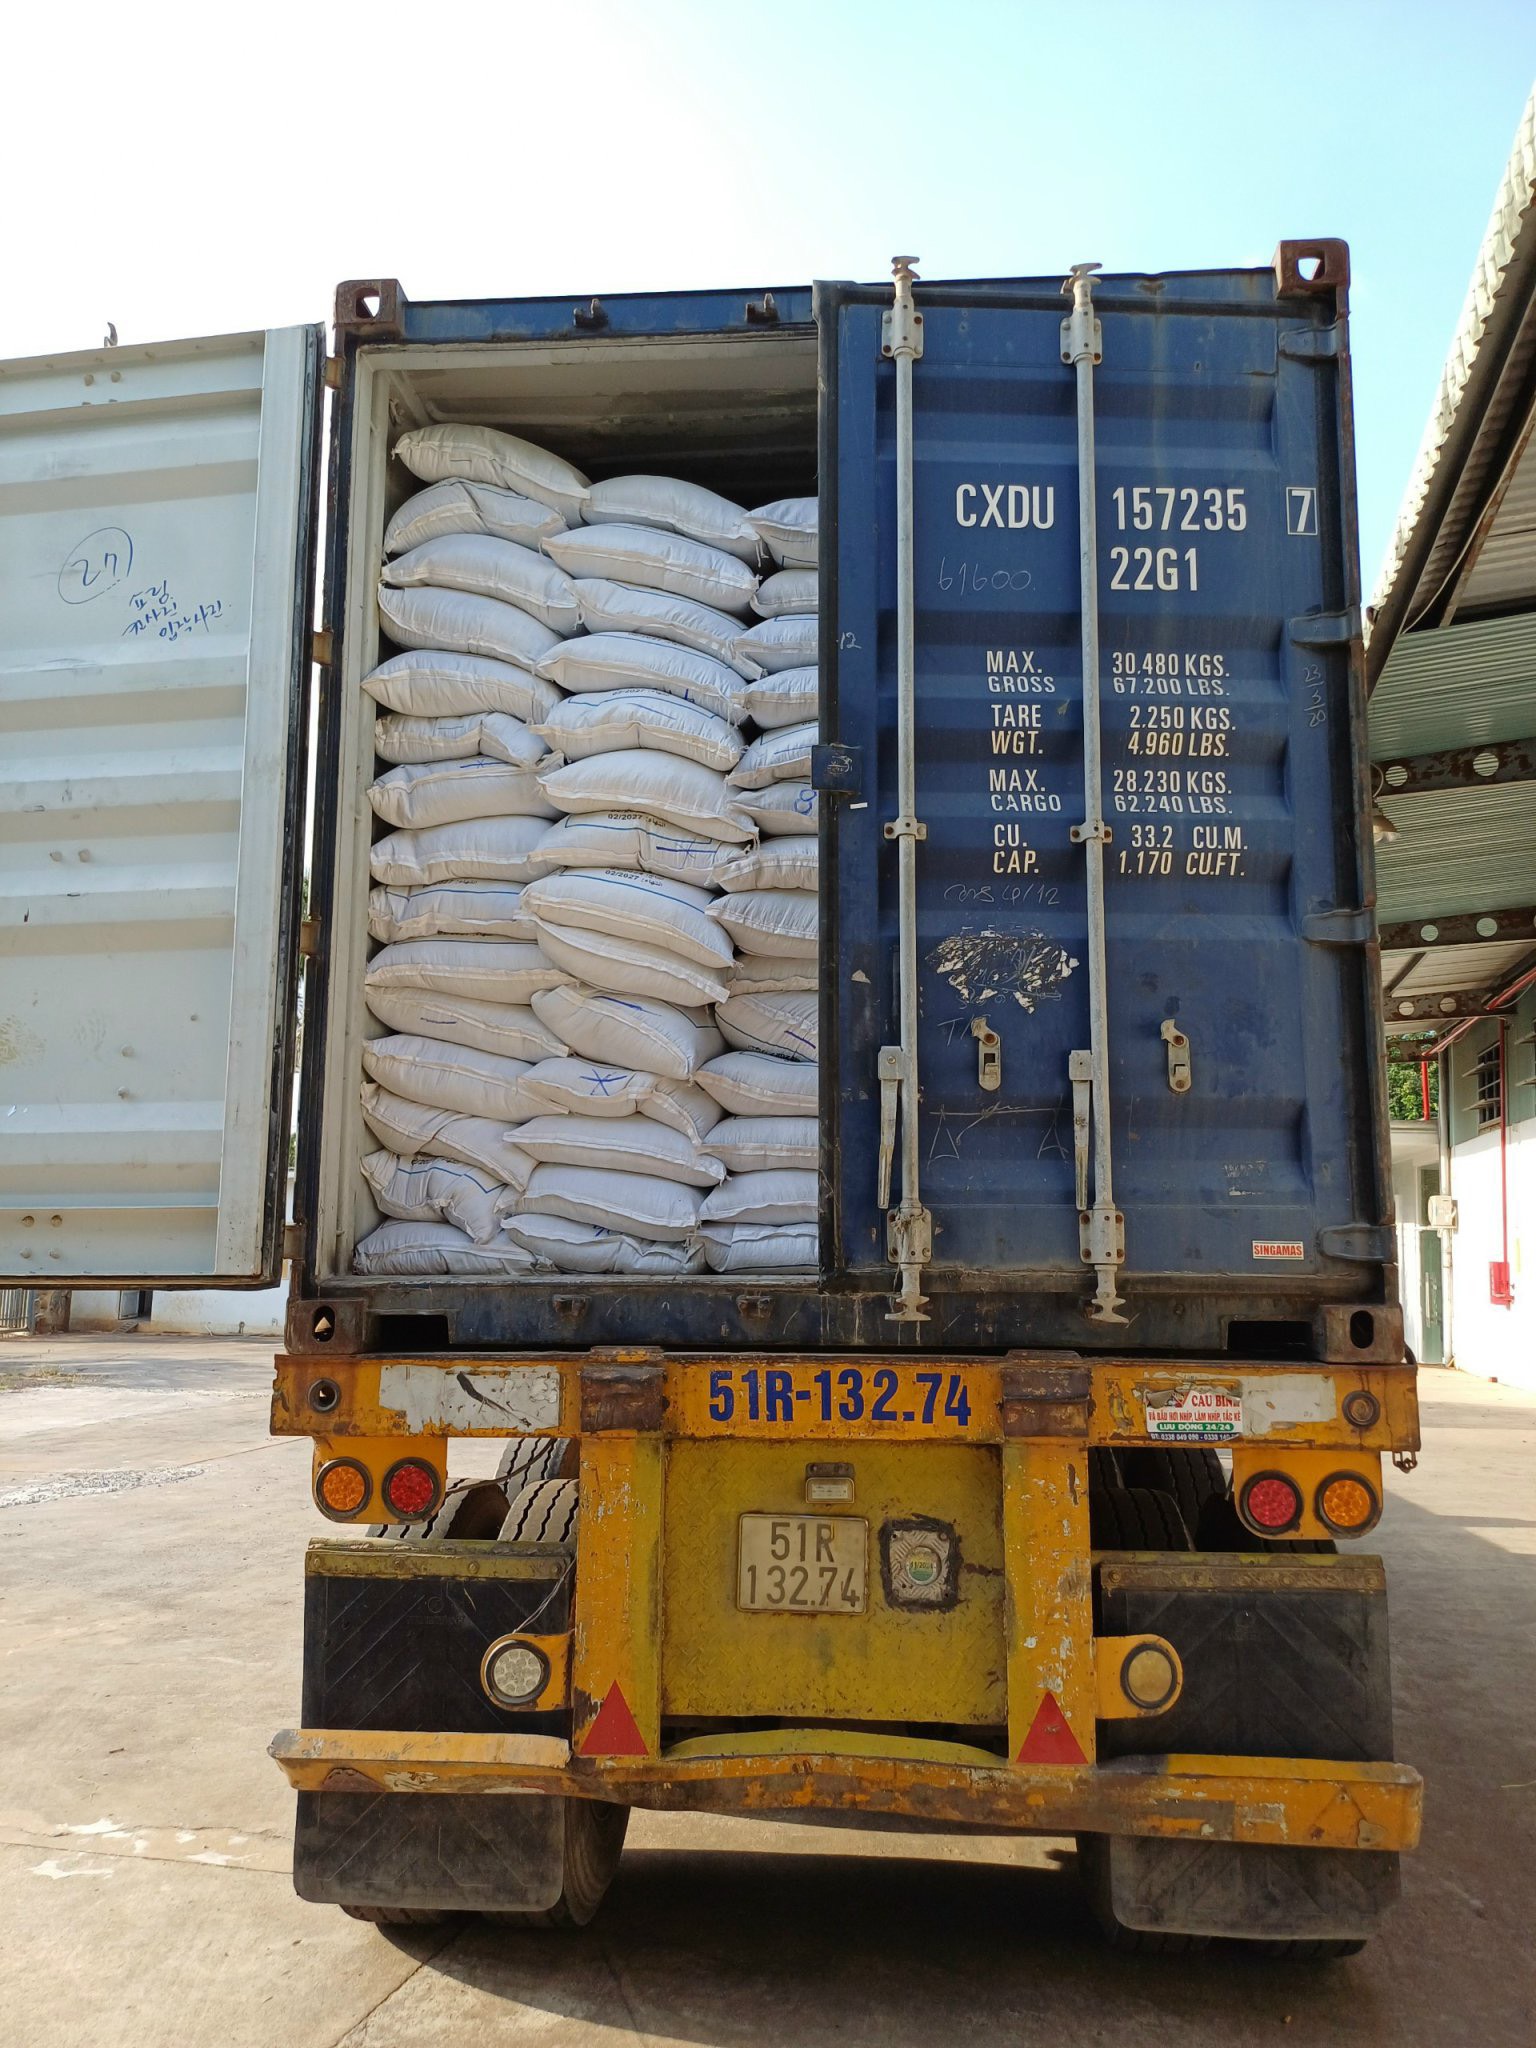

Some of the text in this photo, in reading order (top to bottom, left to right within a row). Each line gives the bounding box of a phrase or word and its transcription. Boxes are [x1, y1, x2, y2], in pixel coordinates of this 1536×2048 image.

[956, 483, 1312, 533] CXDU 157235 7
[1110, 546, 1198, 591] 22G1
[986, 650, 1230, 677] MAX. 30.480 KGS.
[987, 675, 1230, 696] GROSS 67.200 LBS.
[990, 704, 1236, 731] TARE 2.250 KGS.
[991, 730, 1230, 757] WGT. 4.960 LBS.
[989, 769, 1232, 794] MAX. 28.230 KGS.
[990, 794, 1233, 814] CARGO 62.240 LBS.
[994, 823, 1248, 850] CU. 33.2 CU.M.
[993, 850, 1245, 876] CAP. 1.170 CU.FT.
[1253, 1244, 1303, 1256] SINGAMAS
[708, 1368, 972, 1427] 51R-132.74
[770, 1522, 835, 1563] 51R
[747, 1565, 860, 1607] 132.74
